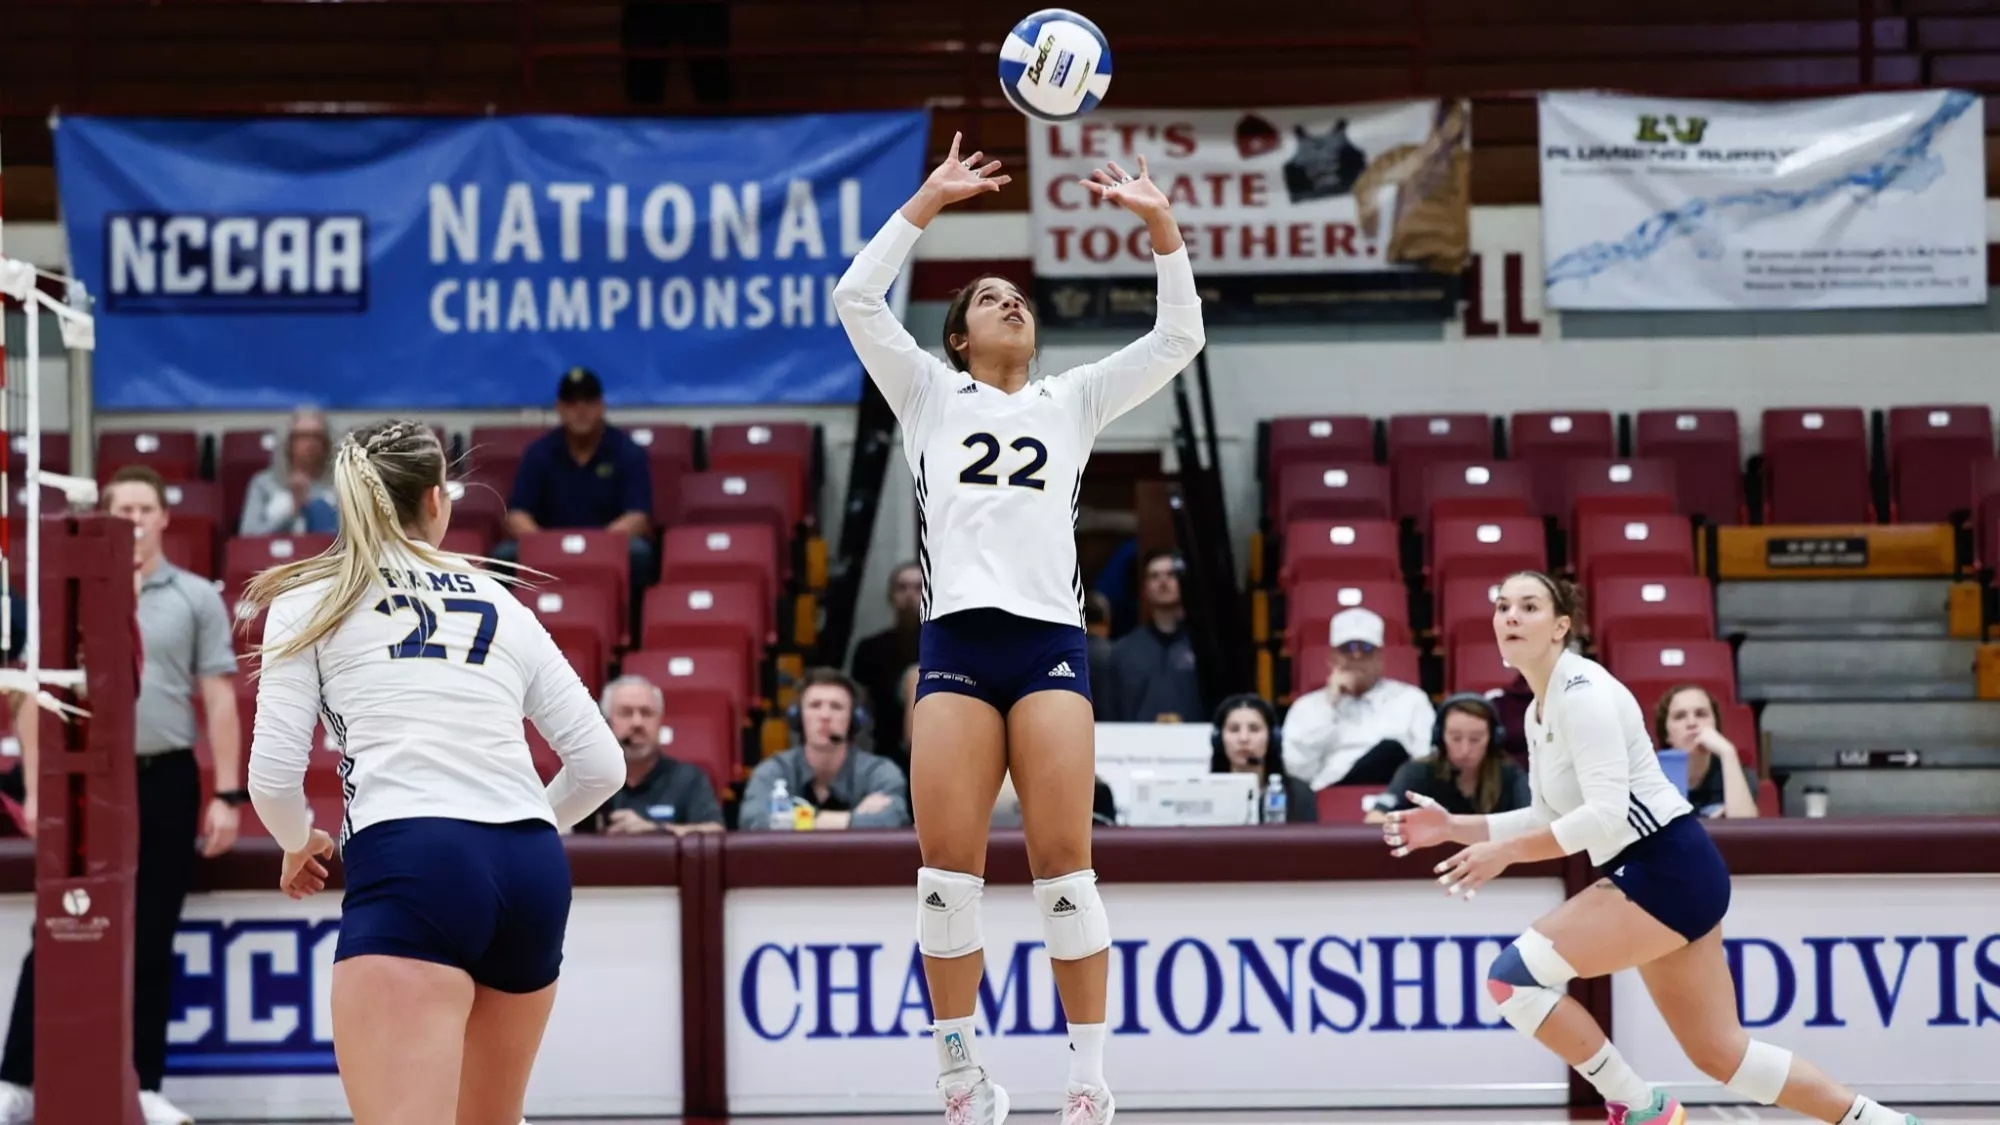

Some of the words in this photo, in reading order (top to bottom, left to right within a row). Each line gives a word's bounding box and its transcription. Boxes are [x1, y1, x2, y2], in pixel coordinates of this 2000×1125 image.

[1027, 34, 1056, 86] Baden
[1048, 123, 1199, 158] LET'S
[428, 178, 872, 264] NATIONAL
[1046, 172, 1268, 212] CATE
[110, 216, 363, 294] NCCAA
[429, 274, 840, 333] CHAMPIONSHI
[959, 432, 1048, 491] 22
[374, 594, 499, 665] 27
[740, 935, 1521, 1041] CHAMIONSHI
